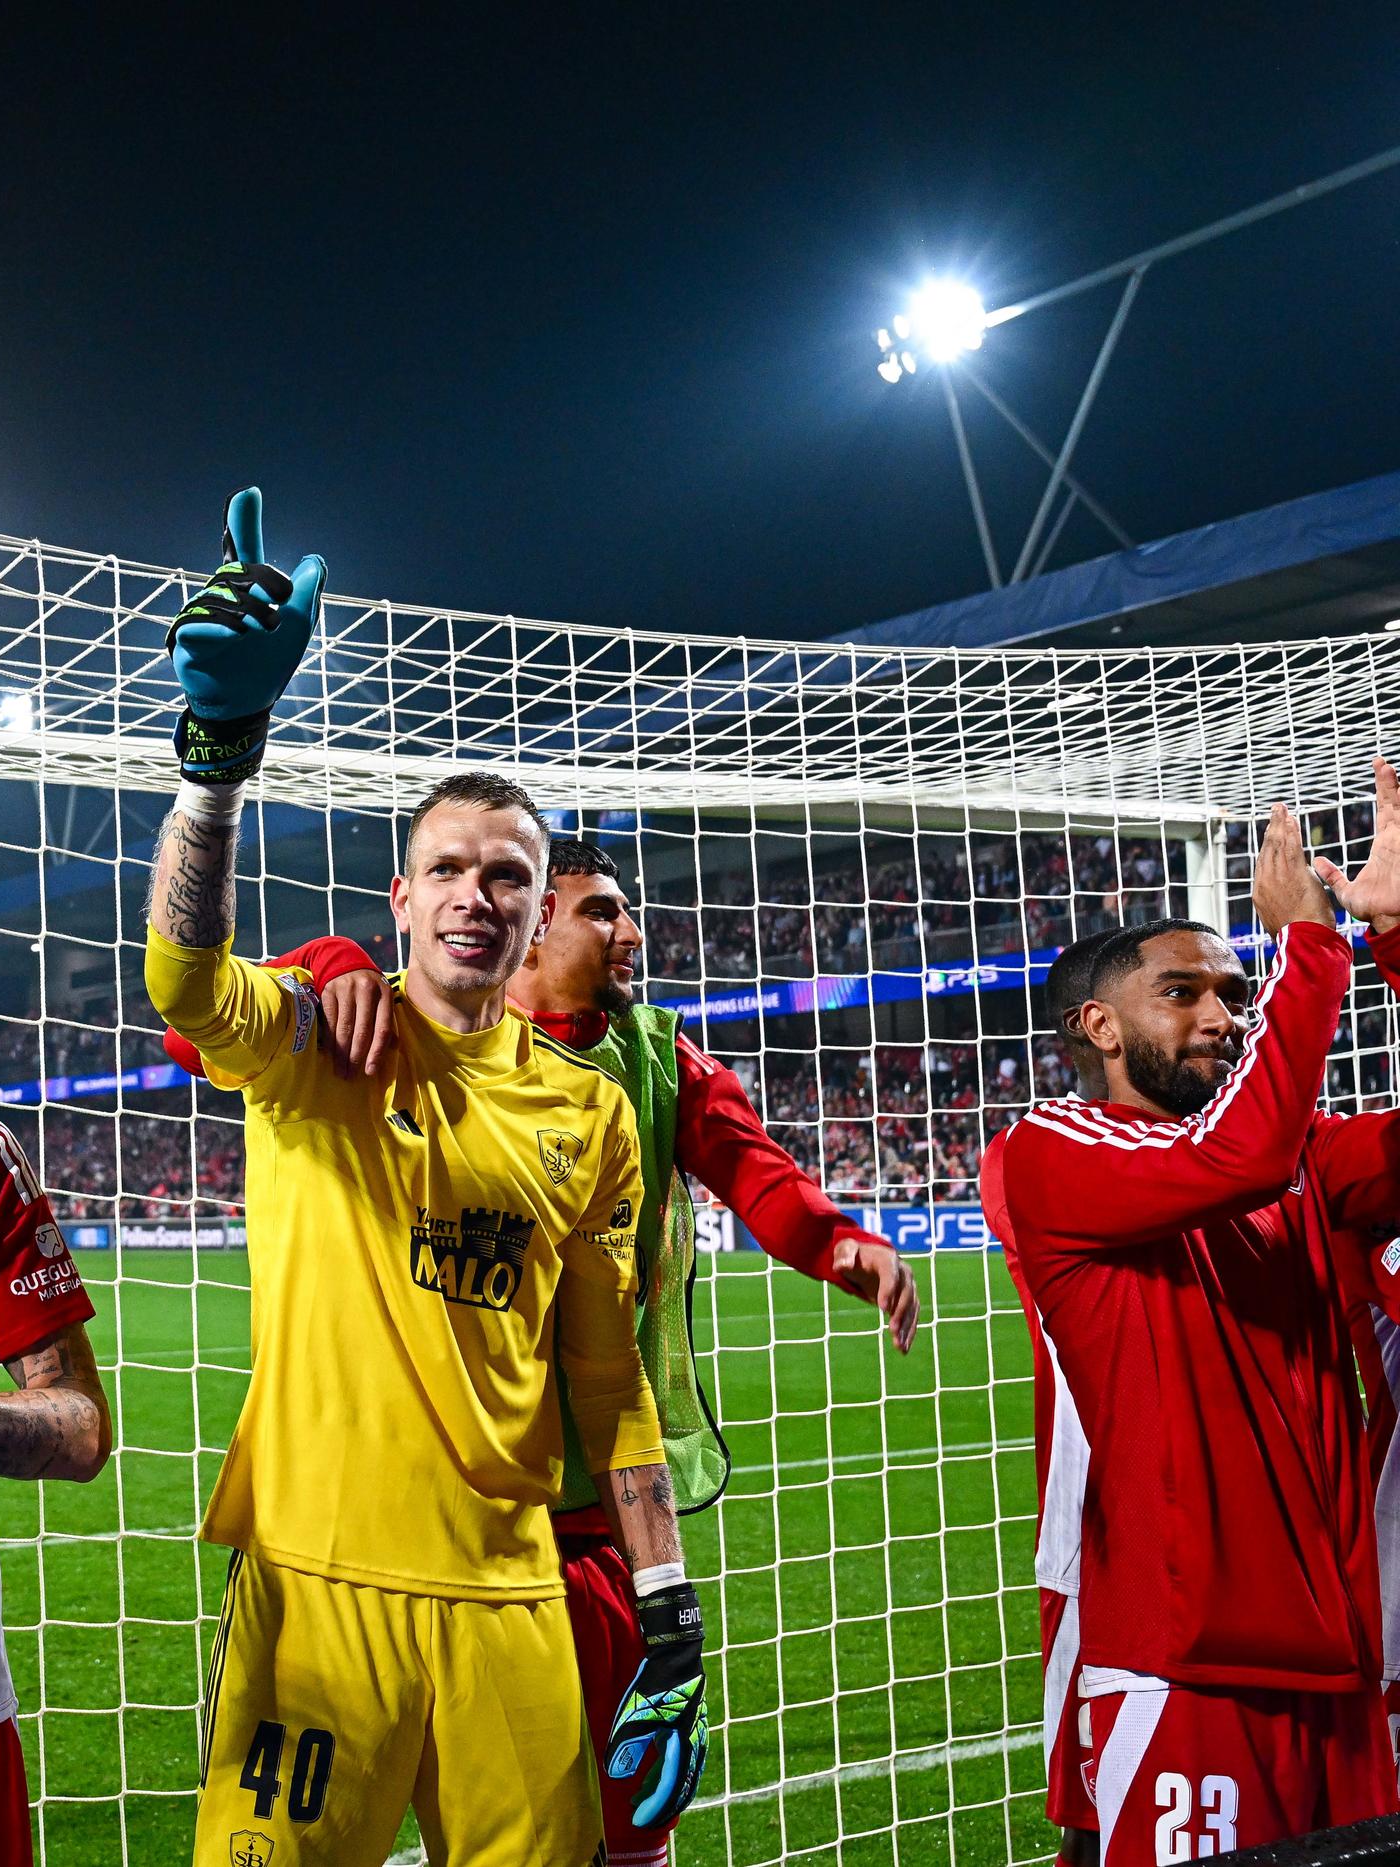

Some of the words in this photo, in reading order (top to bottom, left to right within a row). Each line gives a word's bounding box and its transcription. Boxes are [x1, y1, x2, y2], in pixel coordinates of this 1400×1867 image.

[896, 1213, 992, 1245] PS5
[415, 1244, 515, 1308] MALO
[239, 1719, 336, 1824] 40
[1154, 1772, 1240, 1867] 23
